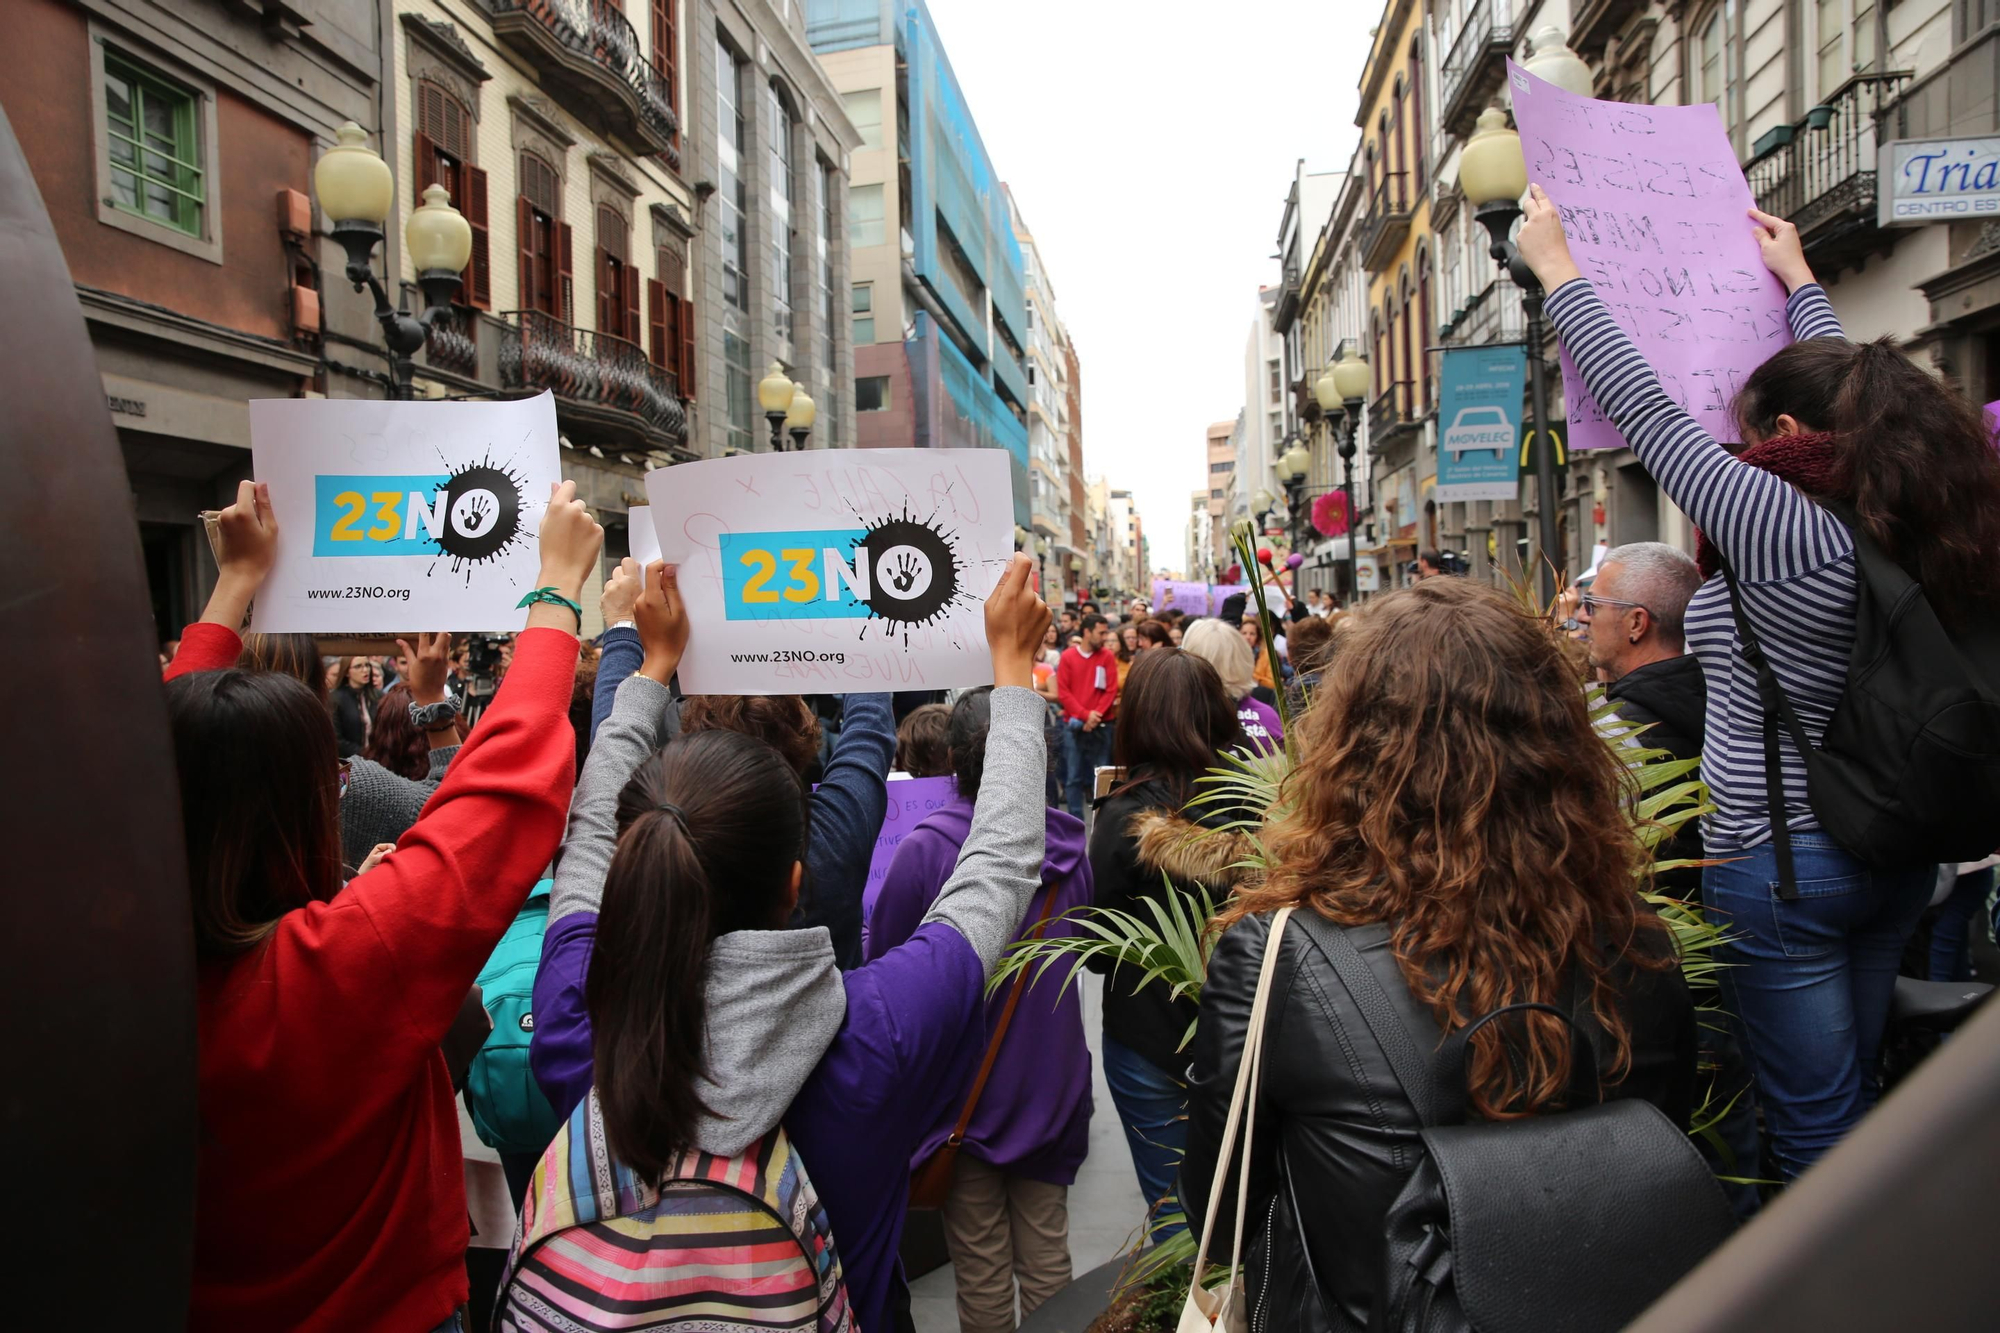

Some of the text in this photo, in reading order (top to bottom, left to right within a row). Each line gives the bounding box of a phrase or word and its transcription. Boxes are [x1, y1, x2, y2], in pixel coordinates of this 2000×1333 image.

[1897, 199, 2000, 216] CENTRO ES
[1447, 431, 1511, 446] MOVELEC
[330, 470, 518, 556] 23NO
[740, 525, 945, 617] 23NO
[307, 585, 411, 601] www.23NO.org
[731, 650, 845, 664] www.23NO.org
[1236, 708, 1260, 721] ada
[906, 800, 919, 812] ES
[875, 835, 902, 849] TIVE
